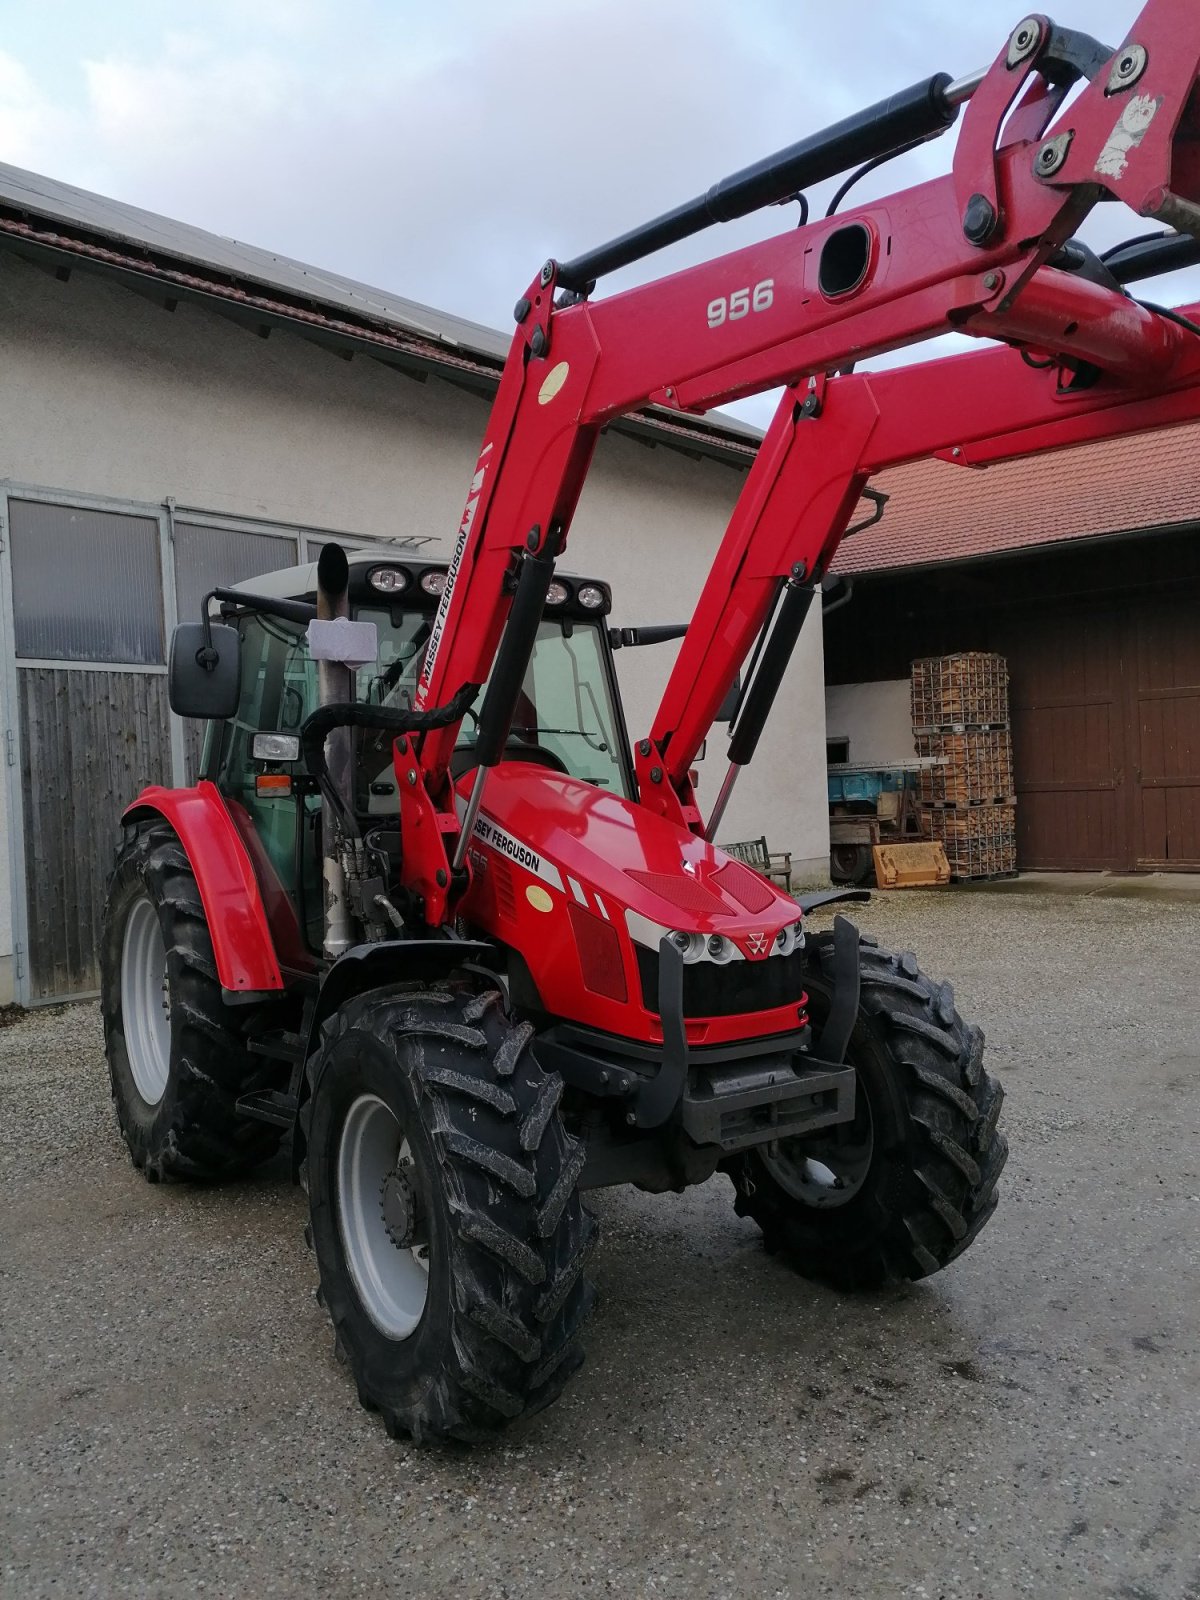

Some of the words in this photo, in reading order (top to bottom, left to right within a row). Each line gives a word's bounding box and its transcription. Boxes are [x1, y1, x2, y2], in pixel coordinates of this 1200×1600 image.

[707, 278, 775, 329] 956
[423, 621, 443, 684] MASSEY
[439, 530, 468, 618] FERGUSON
[491, 829, 540, 873] FERGUSON
